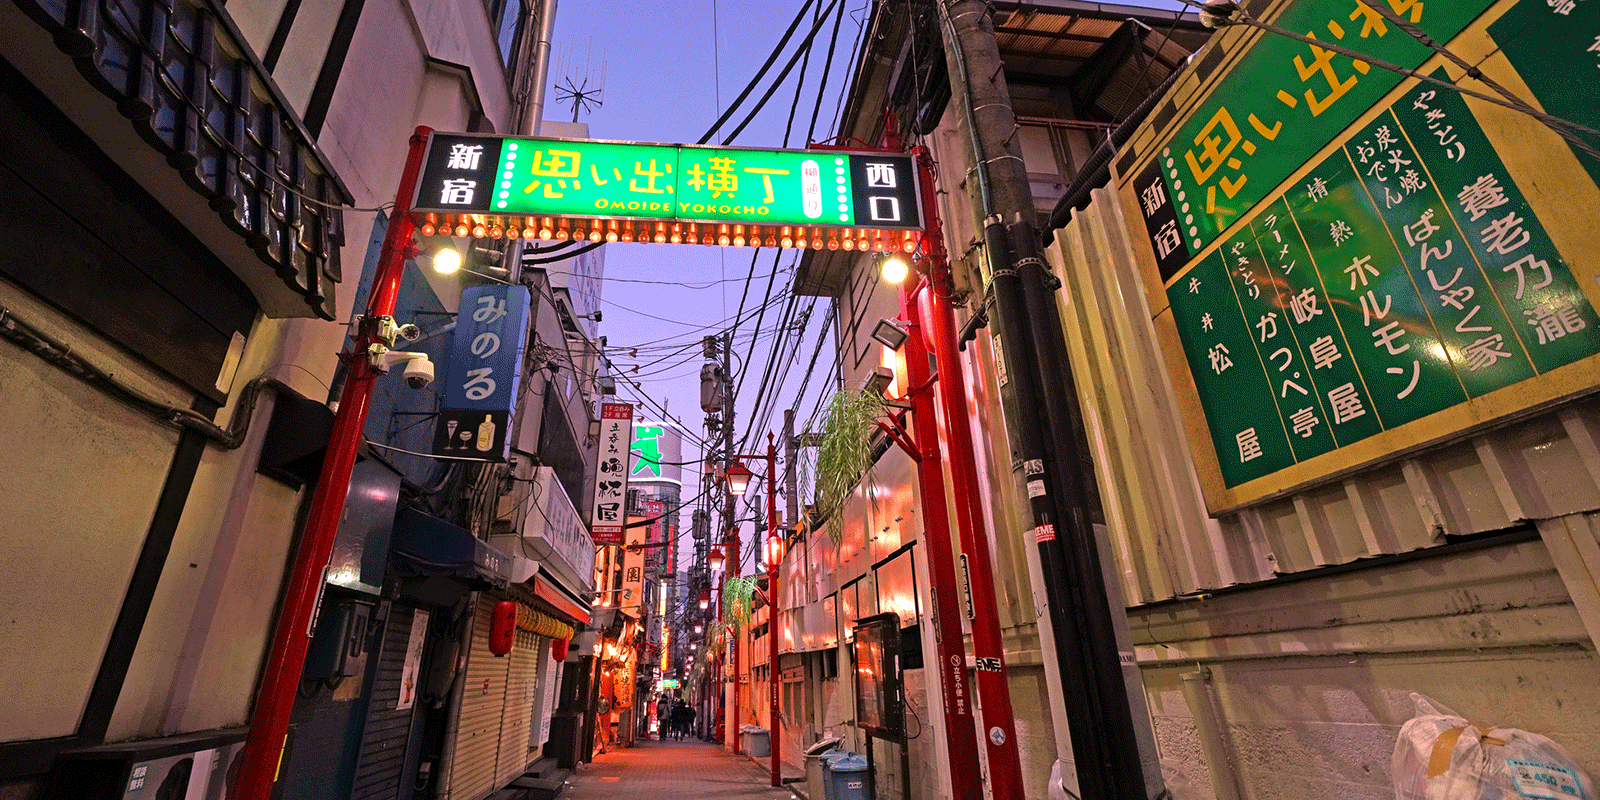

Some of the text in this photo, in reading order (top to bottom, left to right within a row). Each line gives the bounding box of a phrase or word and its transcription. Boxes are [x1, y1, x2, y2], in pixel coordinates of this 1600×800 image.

[440, 143, 484, 205] 新宿
[523, 148, 790, 204] 思い出横丁
[865, 162, 901, 222] 西口
[1374, 125, 1427, 196] 炭火焼
[594, 197, 770, 216] OMOIDE YOKOCHO
[1141, 176, 1182, 260] 新宿
[1412, 90, 1586, 345] やきとり 養老乃瀧
[1231, 241, 1260, 300] やきとり
[1306, 177, 1420, 400] 情熱 ホルモン
[1356, 140, 1512, 372] おでん ばんしゃく家
[462, 295, 507, 401] みのる
[1264, 213, 1366, 425] ラーメン 岐阜屋
[1188, 277, 1263, 463] 牛丼 松屋
